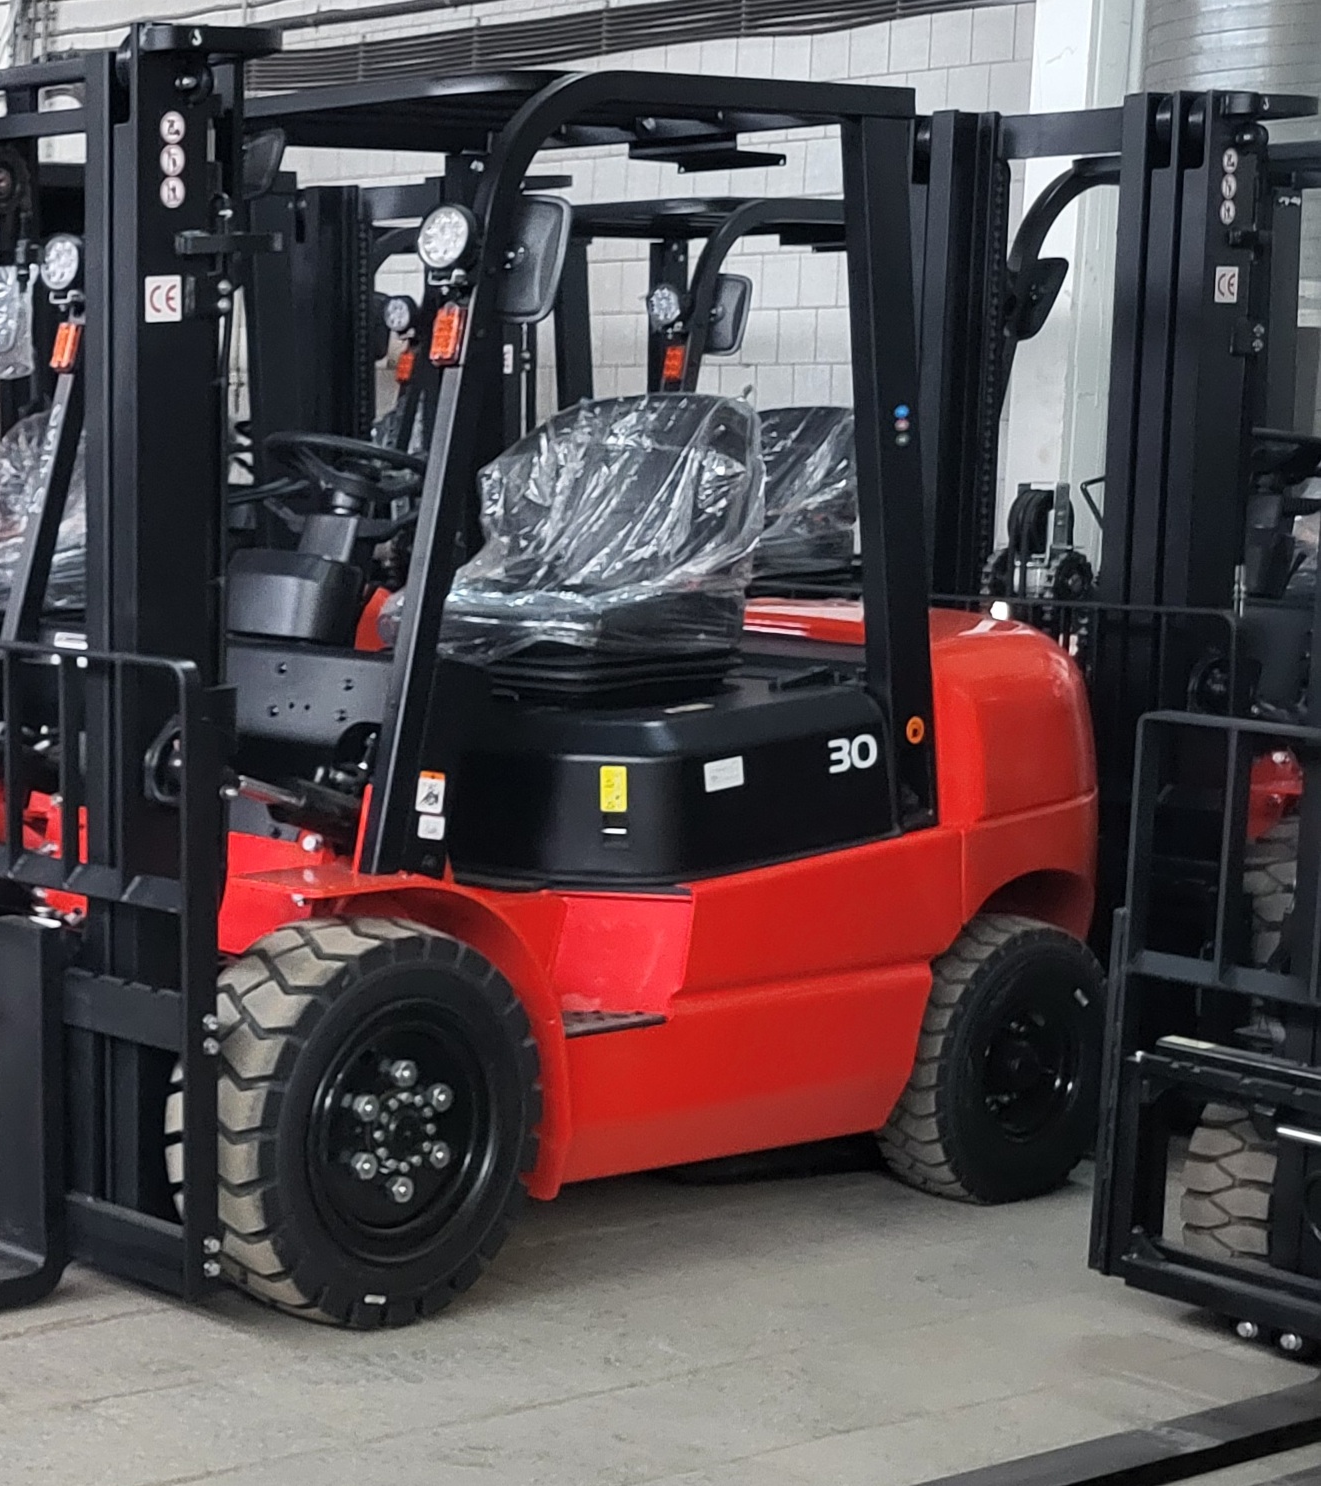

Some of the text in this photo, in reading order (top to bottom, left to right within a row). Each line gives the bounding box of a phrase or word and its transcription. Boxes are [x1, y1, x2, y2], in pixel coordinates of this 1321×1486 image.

[150, 284, 177, 313] CE
[1218, 273, 1235, 297] CE
[828, 734, 877, 774] 30
